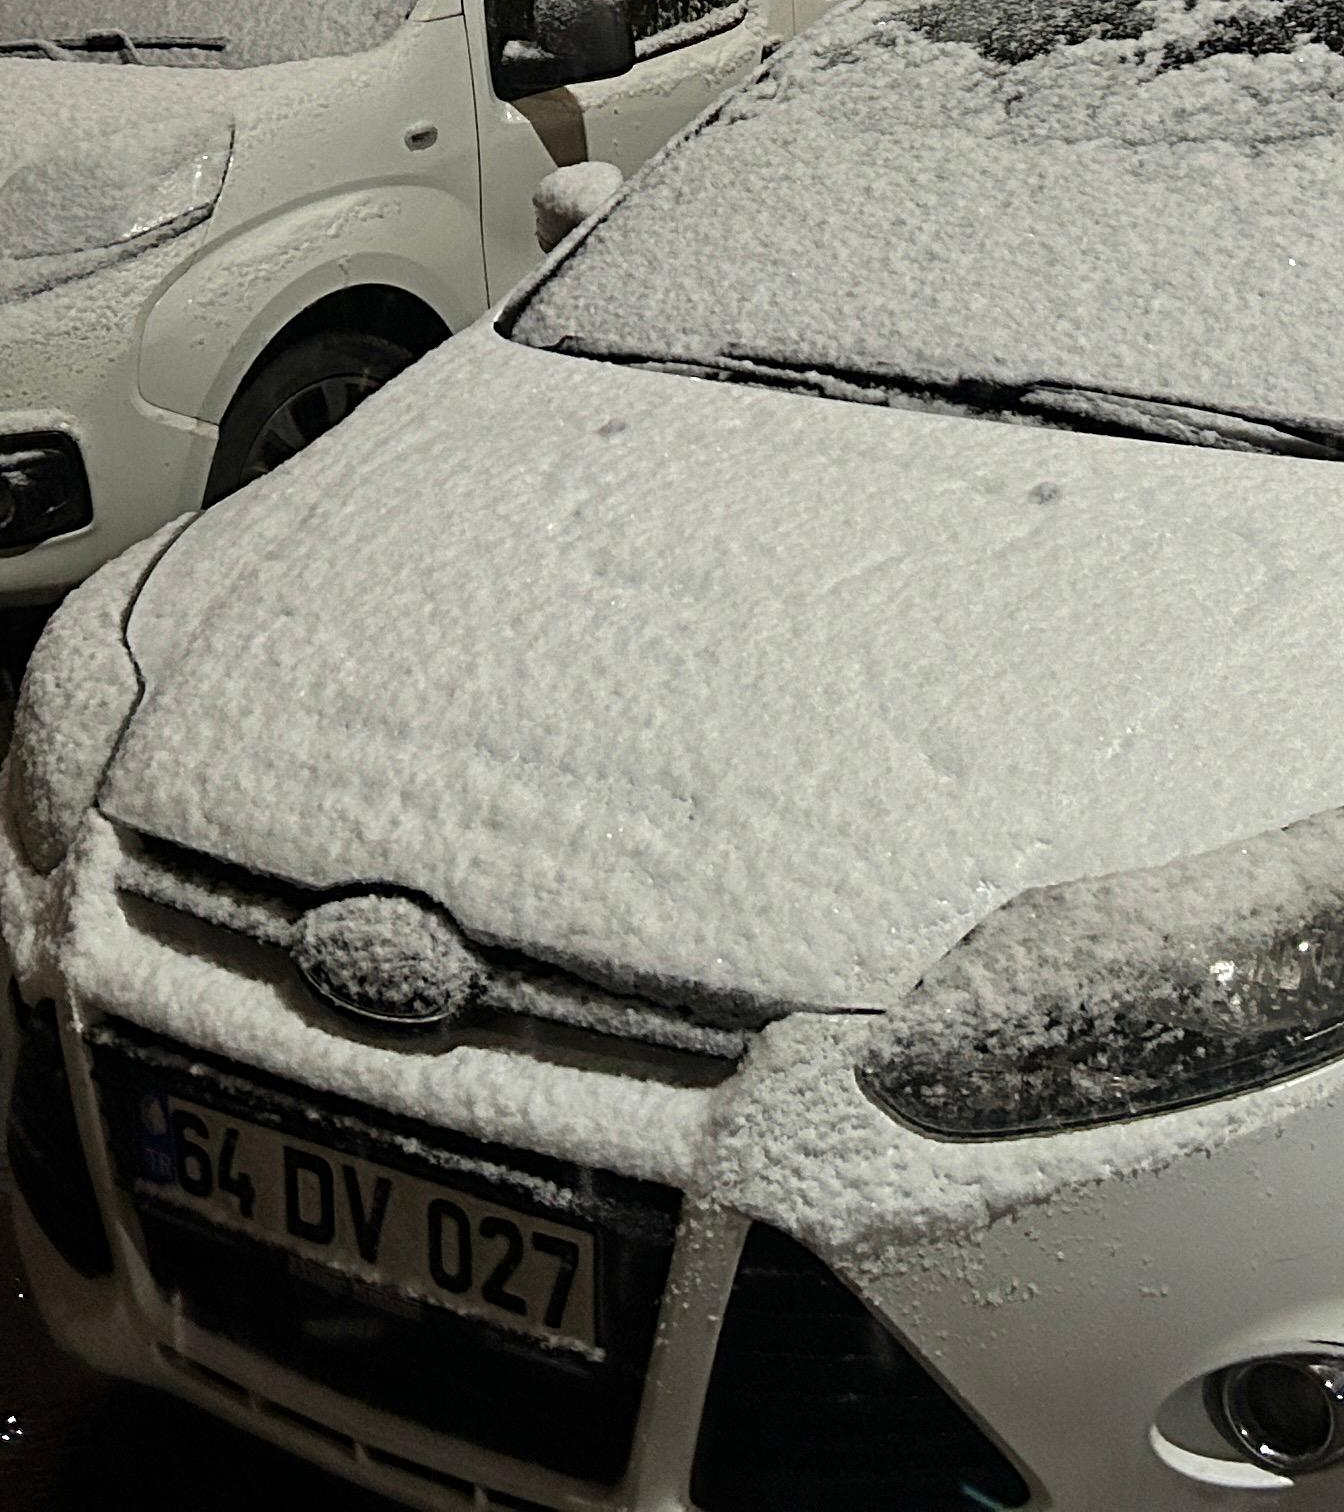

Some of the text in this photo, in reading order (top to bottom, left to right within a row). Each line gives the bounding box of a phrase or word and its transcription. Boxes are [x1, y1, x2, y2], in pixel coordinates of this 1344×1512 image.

[172, 1109, 579, 1329] 64 DV 027
